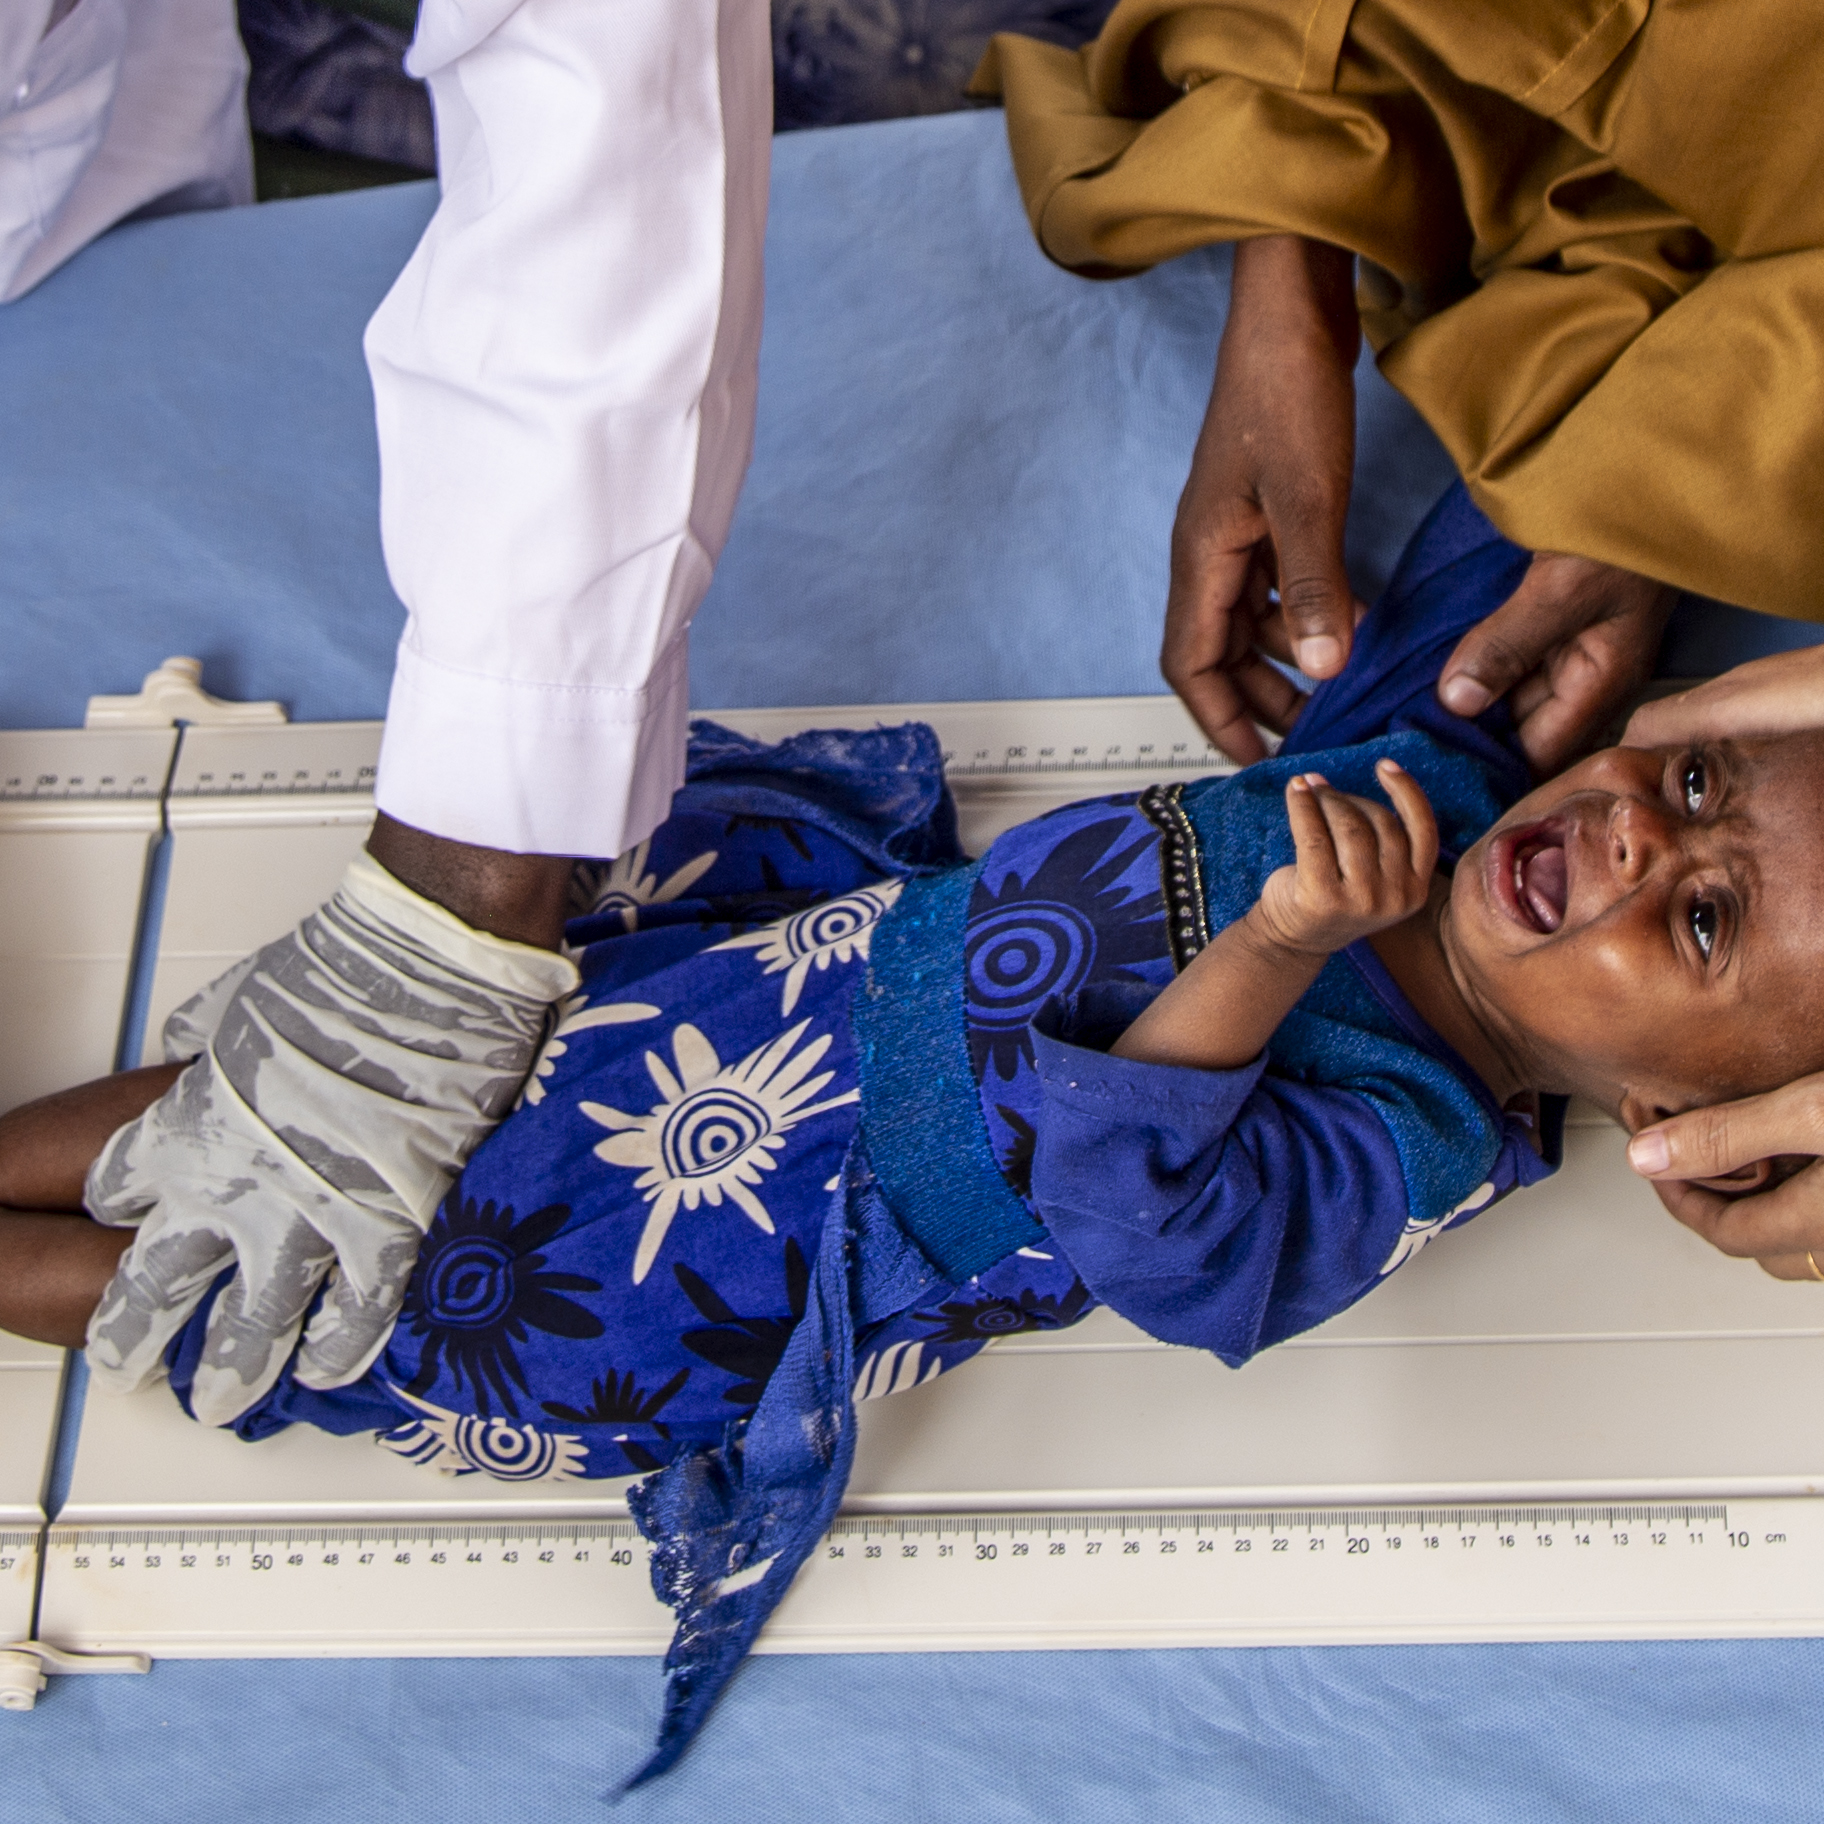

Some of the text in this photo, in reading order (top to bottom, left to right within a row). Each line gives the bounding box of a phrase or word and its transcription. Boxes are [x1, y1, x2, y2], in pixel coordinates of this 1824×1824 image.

[0, 1558, 15, 1570] 57
[74, 1556, 90, 1568] 55
[110, 1555, 125, 1567] 54
[145, 1556, 161, 1568] 53
[181, 1555, 196, 1567] 52
[216, 1555, 230, 1567] 51
[251, 1554, 273, 1570] 50
[287, 1554, 303, 1566] 49
[322, 1553, 339, 1566] 48
[358, 1553, 374, 1564] 47
[394, 1552, 411, 1565] 46
[430, 1552, 446, 1564] 45
[466, 1552, 482, 1563] 44
[502, 1551, 518, 1563] 43
[538, 1551, 554, 1564] 42
[574, 1551, 589, 1563] 41
[610, 1550, 632, 1566] 40
[828, 1546, 845, 1559] 34
[865, 1546, 882, 1558] 33
[902, 1545, 918, 1558] 32
[938, 1544, 953, 1557] 31
[975, 1544, 997, 1561] 30
[1012, 1543, 1029, 1556] 29
[1049, 1543, 1066, 1555] 28
[1086, 1542, 1102, 1555] 27
[1123, 1541, 1140, 1554] 26
[1160, 1541, 1177, 1554] 25
[1197, 1540, 1214, 1553] 24
[1235, 1539, 1251, 1552] 23
[1272, 1539, 1289, 1551] 22
[1310, 1538, 1324, 1551] 21
[1347, 1537, 1370, 1554] 20
[1386, 1537, 1401, 1549] 19
[1423, 1536, 1439, 1549] 18
[1461, 1535, 1476, 1547] 17
[1499, 1535, 1515, 1547] 16
[1537, 1534, 1552, 1547] 15
[1575, 1534, 1590, 1545] 14
[1613, 1533, 1628, 1546] 13
[1651, 1532, 1666, 1545] 12
[1689, 1533, 1703, 1543] 11
[1728, 1531, 1749, 1548] 10
[1765, 1533, 1786, 1542] cm
